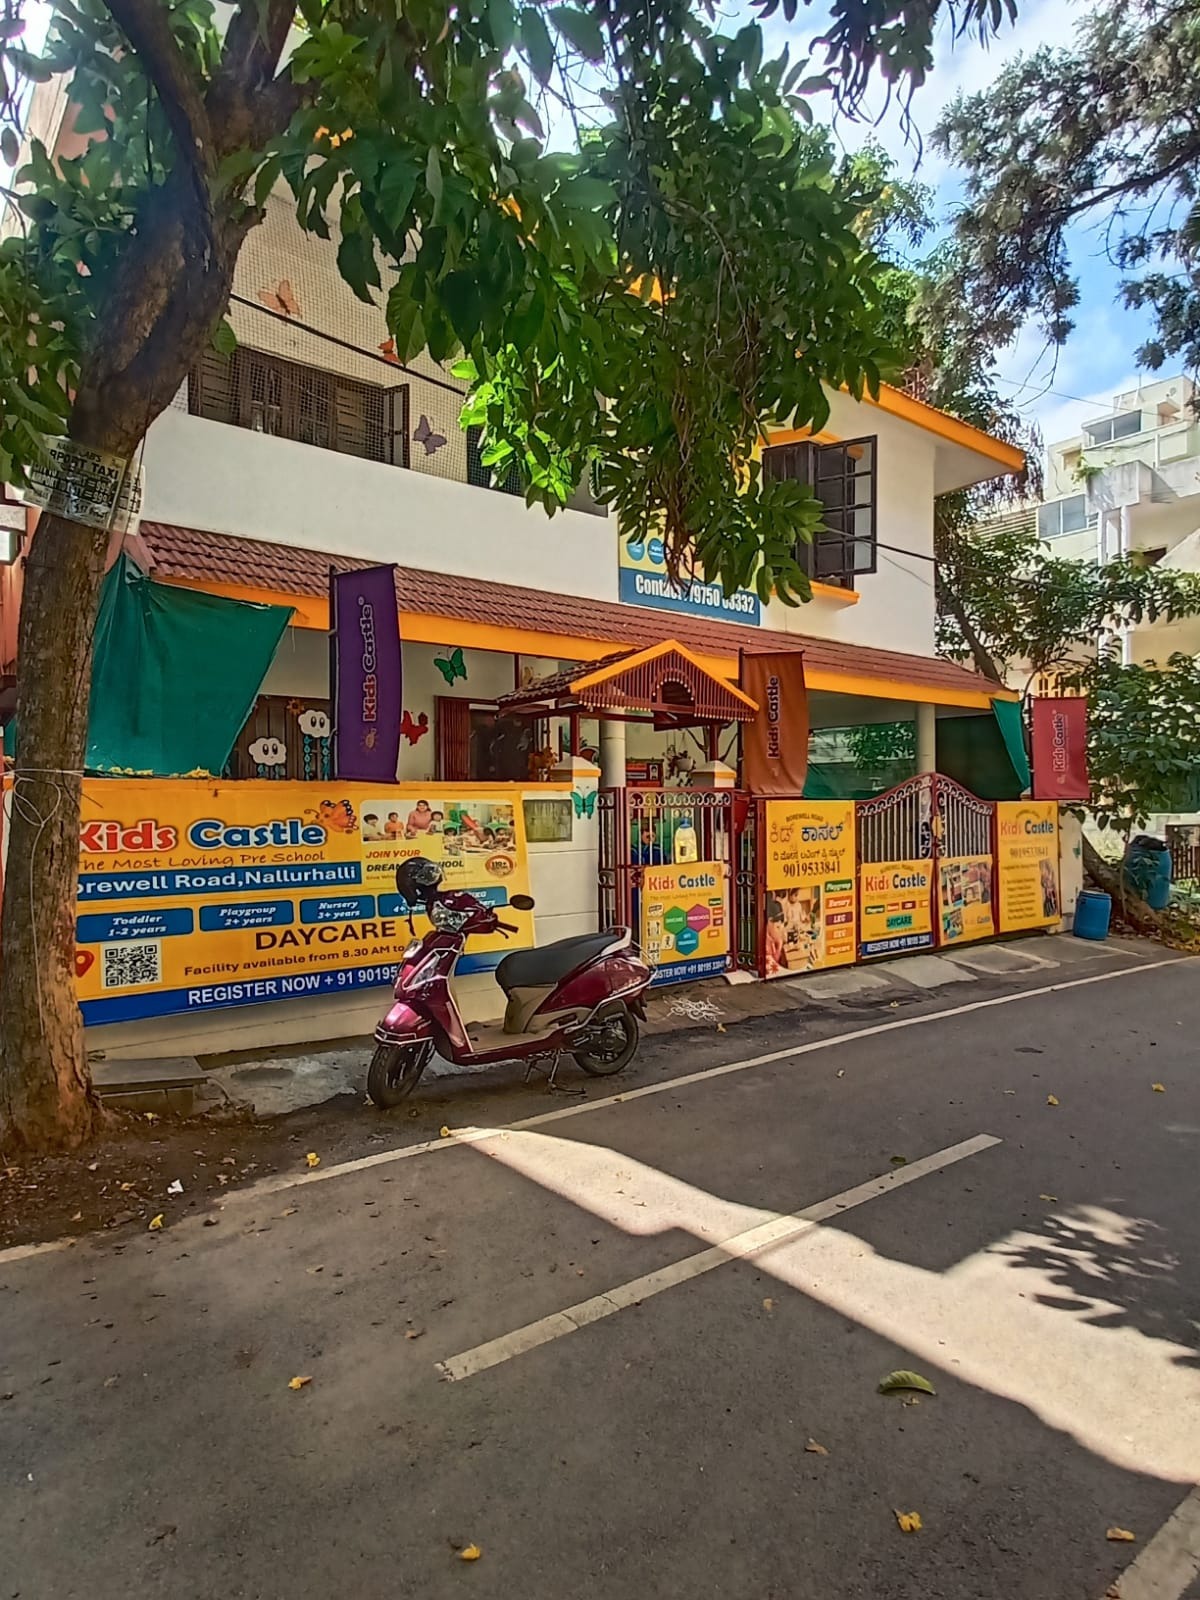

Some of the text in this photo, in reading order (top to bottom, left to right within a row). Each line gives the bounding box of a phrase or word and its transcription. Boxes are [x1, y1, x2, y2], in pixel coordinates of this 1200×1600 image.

[92, 462, 118, 479] TAXI
[360, 604, 377, 722] Kids Castle
[766, 675, 780, 759] Kids Castle
[1052, 713, 1066, 772] Kids Castle
[1024, 819, 1054, 835] Castle
[80, 820, 327, 852] Kids Castle
[112, 858, 160, 869] Most
[168, 855, 234, 868] Loving
[240, 853, 267, 864] Pre
[271, 851, 325, 863] School
[366, 849, 421, 859] JOIN YOUR
[783, 860, 840, 877] 9019533841
[648, 873, 715, 891] Kids Castle
[865, 872, 926, 892] Kids Castle
[219, 906, 276, 917] Playgroup
[318, 901, 358, 910] Nursery
[112, 915, 163, 926] Toddler
[224, 916, 273, 926] 2+ years
[318, 910, 361, 920] 3+ years
[108, 926, 167, 937] 1-2 years
[256, 921, 396, 950] DAYCARE
[184, 963, 239, 976] Facility
[243, 955, 305, 969] available
[309, 953, 339, 962] from
[342, 948, 368, 958] 8.30
[371, 945, 390, 955] AM
[188, 981, 277, 1005] REGISTER
[282, 975, 320, 992] NOW
[337, 972, 353, 985] 91
